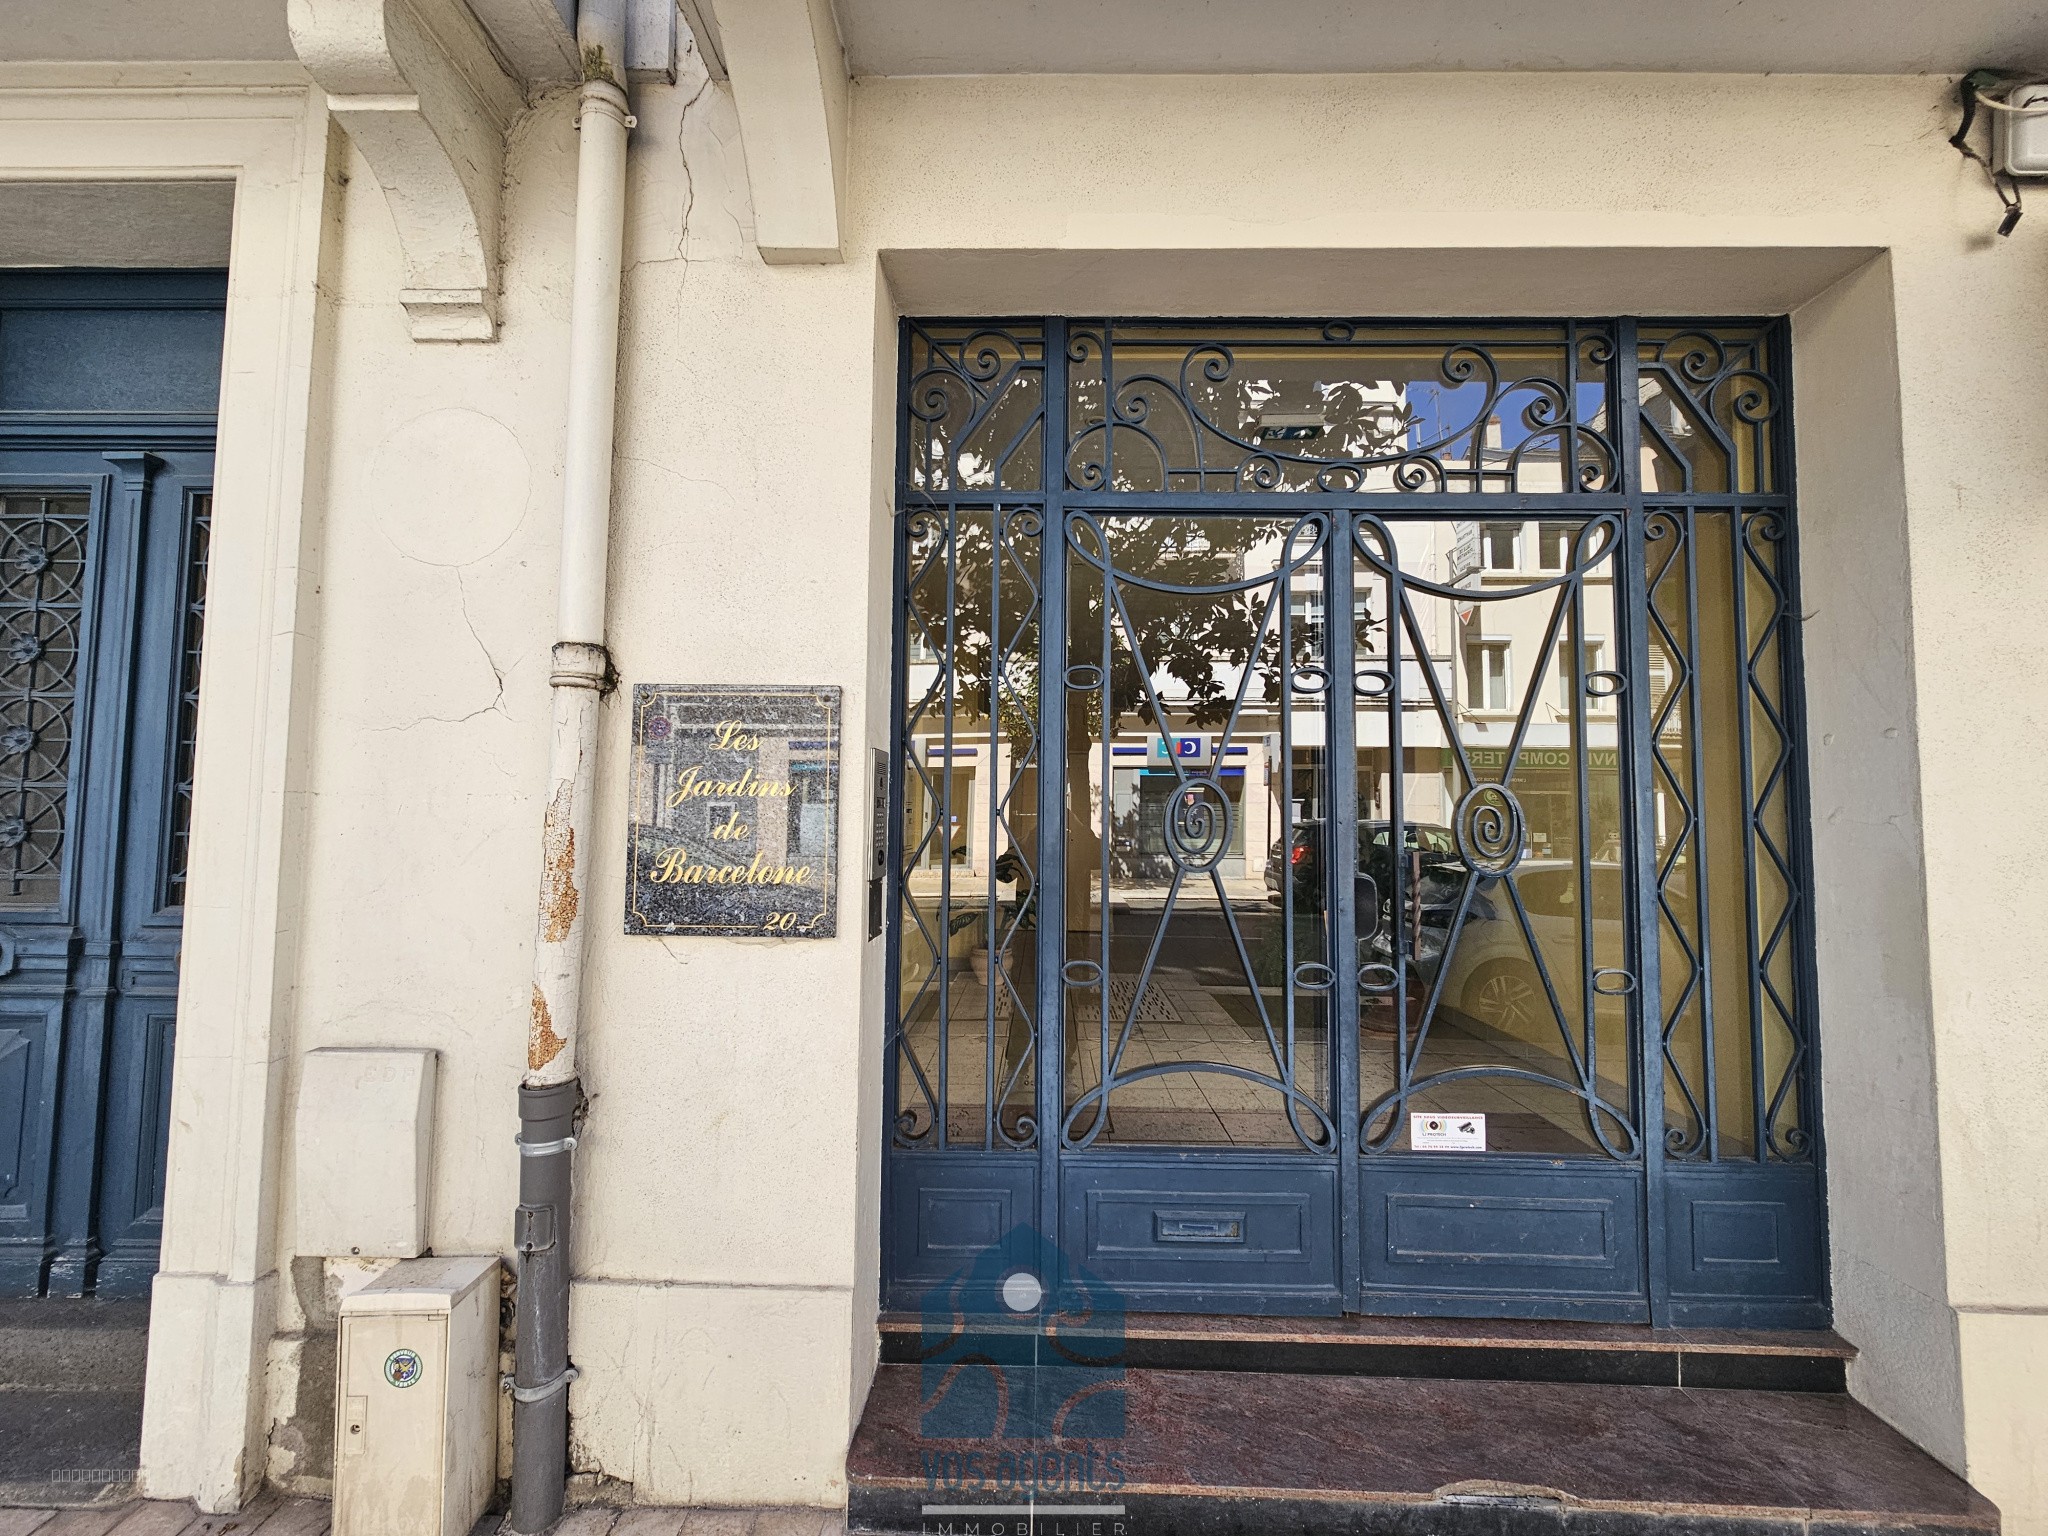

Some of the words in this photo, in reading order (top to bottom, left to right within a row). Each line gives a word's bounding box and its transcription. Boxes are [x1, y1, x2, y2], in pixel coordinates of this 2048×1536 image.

[709, 720, 765, 750] Les
[666, 766, 798, 808] Jardins
[713, 812, 750, 840] de
[650, 847, 817, 884] Barcelone
[763, 912, 797, 931] 20
